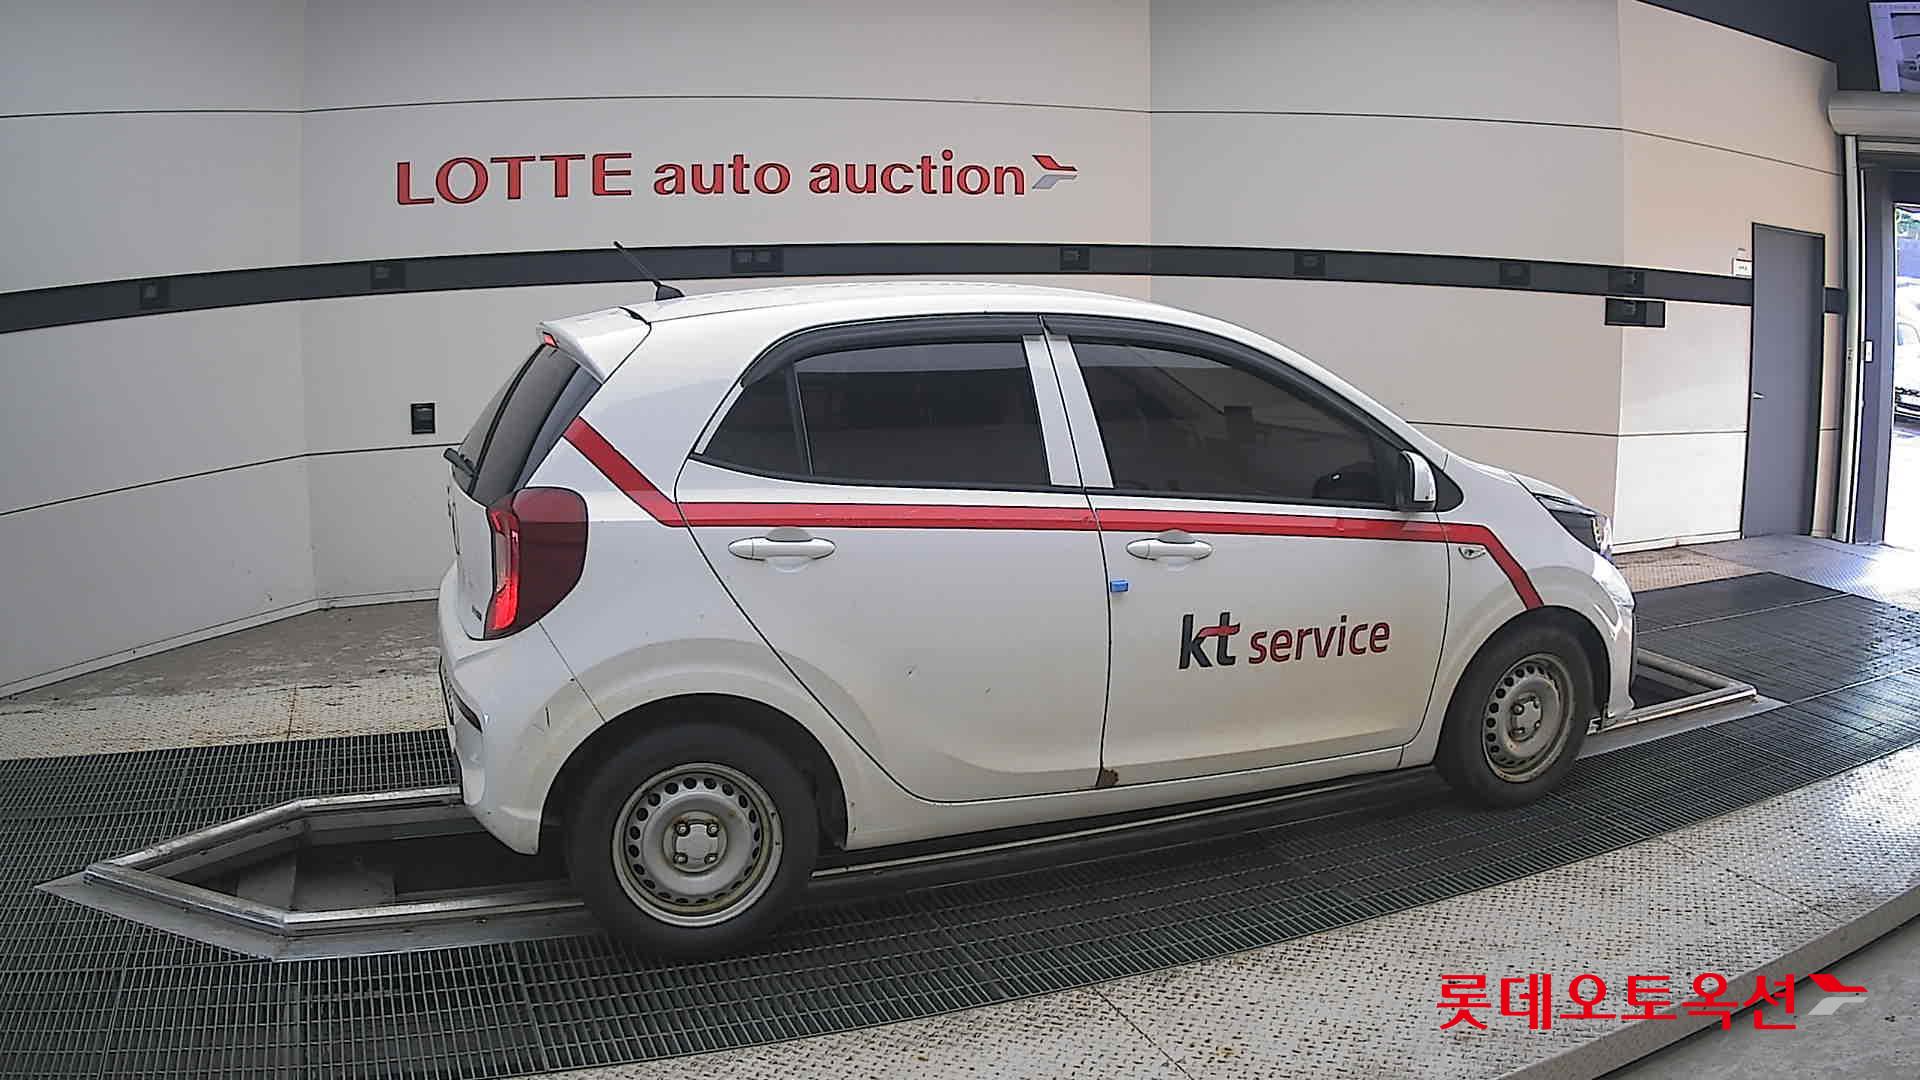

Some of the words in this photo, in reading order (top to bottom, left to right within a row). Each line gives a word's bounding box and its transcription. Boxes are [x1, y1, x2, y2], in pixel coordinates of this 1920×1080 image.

[396, 152, 633, 205] LOTTE
[653, 153, 791, 196] auto
[807, 149, 1026, 197] auction
[1178, 611, 1241, 670] kt
[1248, 614, 1391, 665] service
